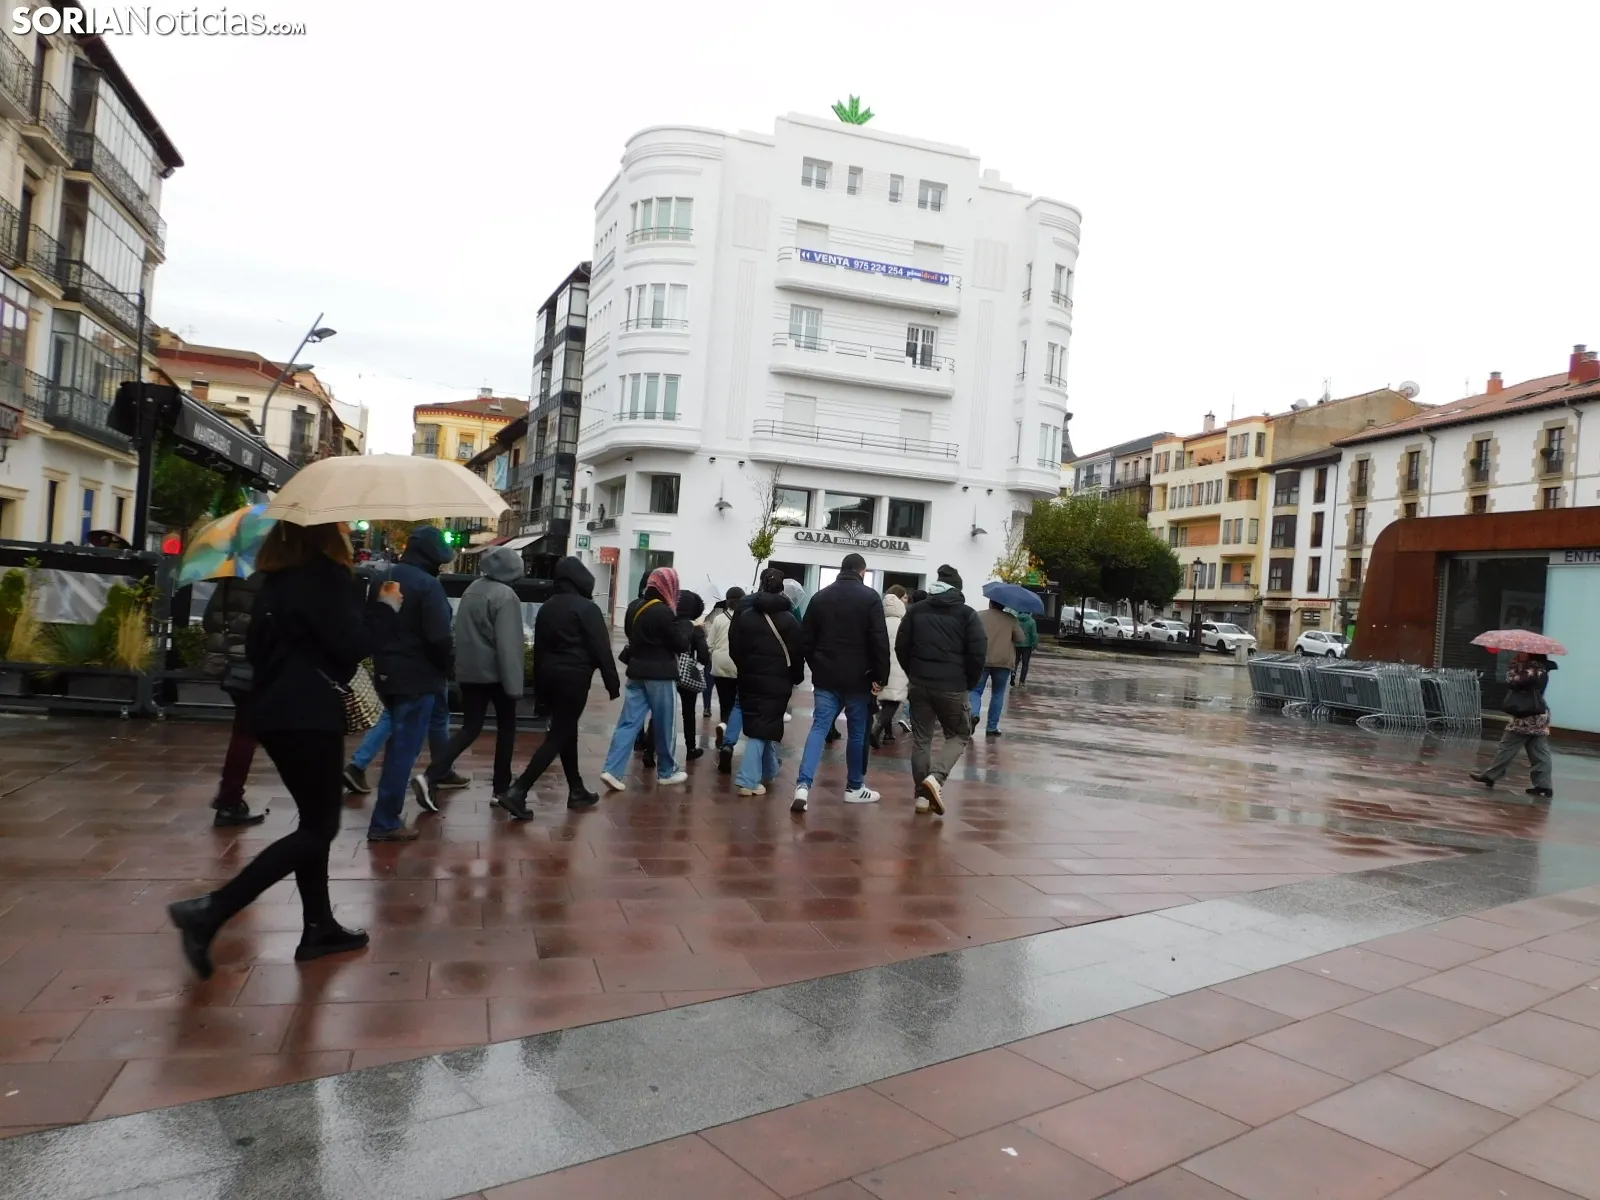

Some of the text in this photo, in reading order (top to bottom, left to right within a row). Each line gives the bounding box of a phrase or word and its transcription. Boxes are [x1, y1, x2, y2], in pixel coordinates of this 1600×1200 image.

[813, 252, 850, 267] VENTA
[853, 260, 869, 271] 975
[871, 263, 887, 273] 224
[888, 266, 904, 276] 254
[794, 531, 911, 552] CAJA RURAL DE SORIA
